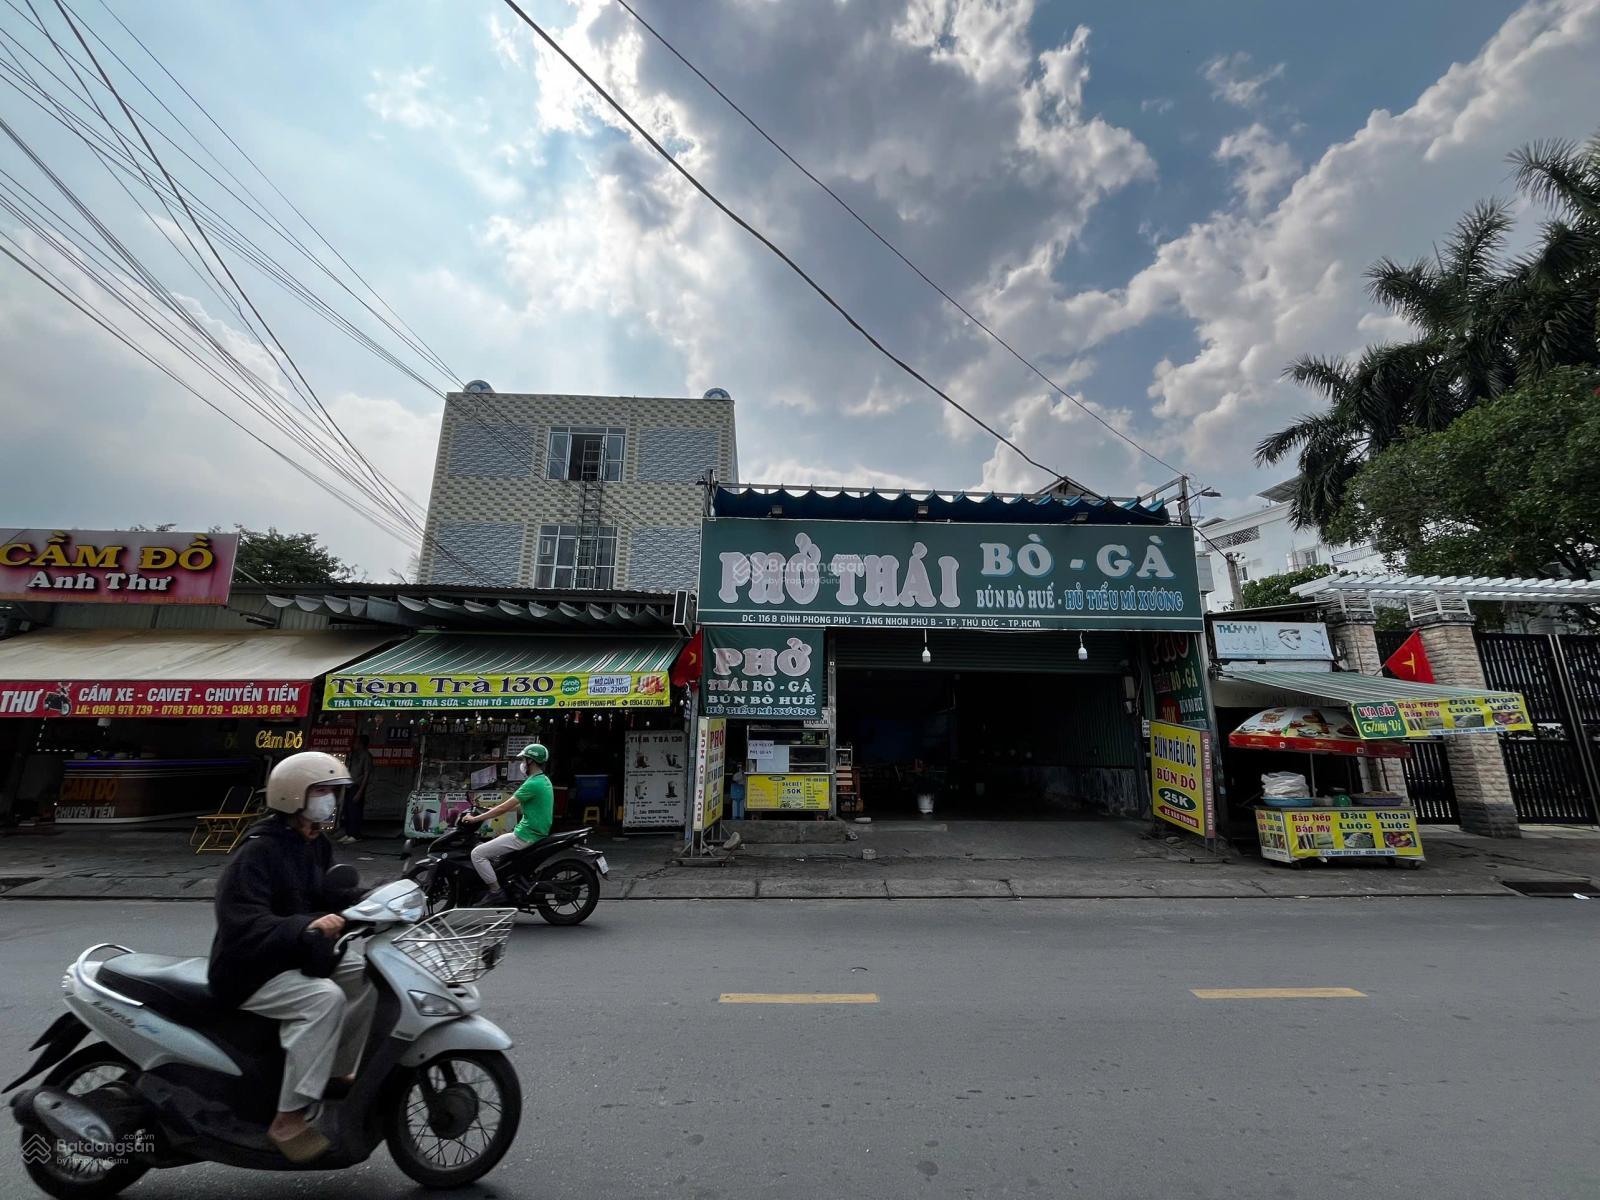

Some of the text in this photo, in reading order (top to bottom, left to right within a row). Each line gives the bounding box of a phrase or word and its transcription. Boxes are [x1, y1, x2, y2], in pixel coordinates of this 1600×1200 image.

[0, 530, 213, 570] CẦM ĐỒ
[980, 534, 1176, 579] BÒ GÀ
[719, 532, 960, 607] PHỞ THÁI
[26, 571, 172, 590] Anh Thư
[976, 585, 1004, 608] BÚN
[1007, 585, 1025, 608] BÒ
[1028, 582, 1055, 608] HUẾ
[1065, 582, 1084, 610] HỦ
[1120, 585, 1137, 610] MÌ
[780, 614, 801, 623] ĐÌNH
[803, 615, 831, 624] PHONG
[886, 617, 908, 625] NHƠN
[982, 616, 999, 626] ĐỨC
[1009, 619, 1041, 627] TP.HCM
[712, 637, 812, 676] PHỞ
[331, 676, 554, 700] Tiệm Trà 130
[708, 677, 813, 692] THÁI BÒ GÀ
[0, 688, 44, 713] THƯ
[115, 688, 135, 702] XE
[147, 688, 192, 702] CAVET
[205, 682, 263, 702] CHUYỂN
[334, 699, 350, 707] TRÀ
[422, 699, 439, 707] TRÀ
[467, 699, 488, 707] SINH
[708, 693, 816, 705] BÚN BÒ HUẾ
[1485, 696, 1520, 704] Khoai
[136, 704, 153, 715] 739
[206, 704, 223, 715] 739
[1157, 767, 1178, 785] BÚN
[1164, 790, 1189, 808] 25K
[1376, 811, 1411, 820] Khoai
[1339, 822, 1372, 831] Luộc
[1381, 821, 1410, 831] Luộc
